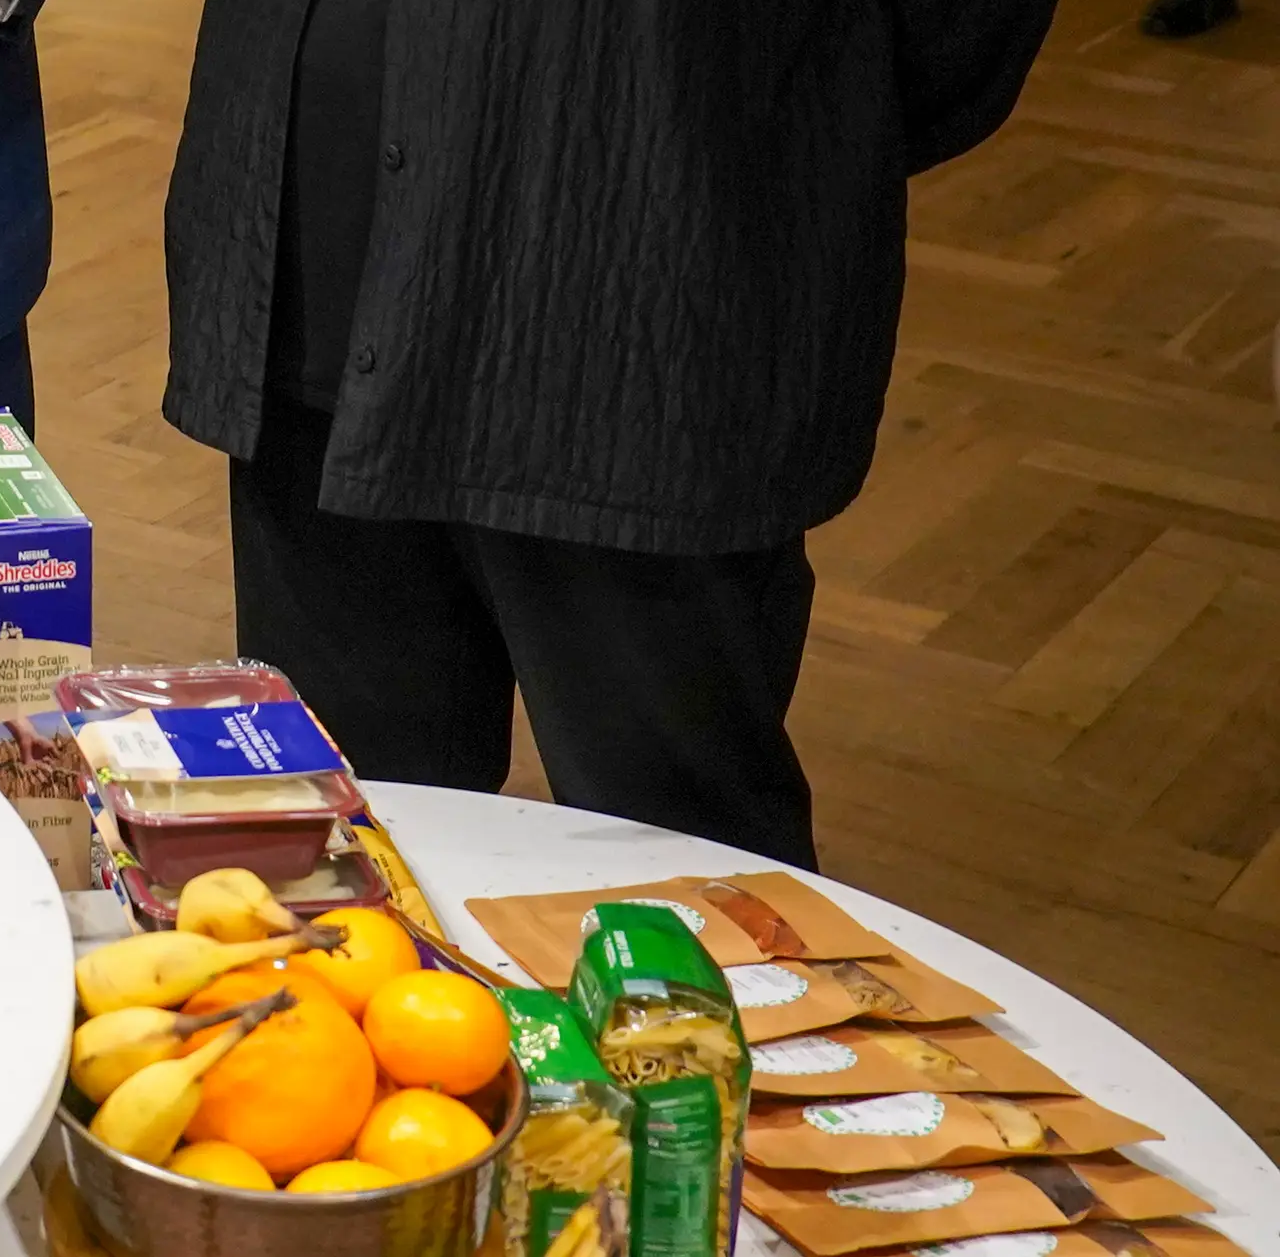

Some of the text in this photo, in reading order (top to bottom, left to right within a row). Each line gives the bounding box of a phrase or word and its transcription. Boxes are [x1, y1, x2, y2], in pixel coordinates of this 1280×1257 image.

[2, 580, 67, 594] THE ORIGINAL
[37, 654, 70, 668] Grain
[20, 681, 50, 694] produ
[20, 691, 51, 703] Whole
[42, 815, 74, 828] Fibre
